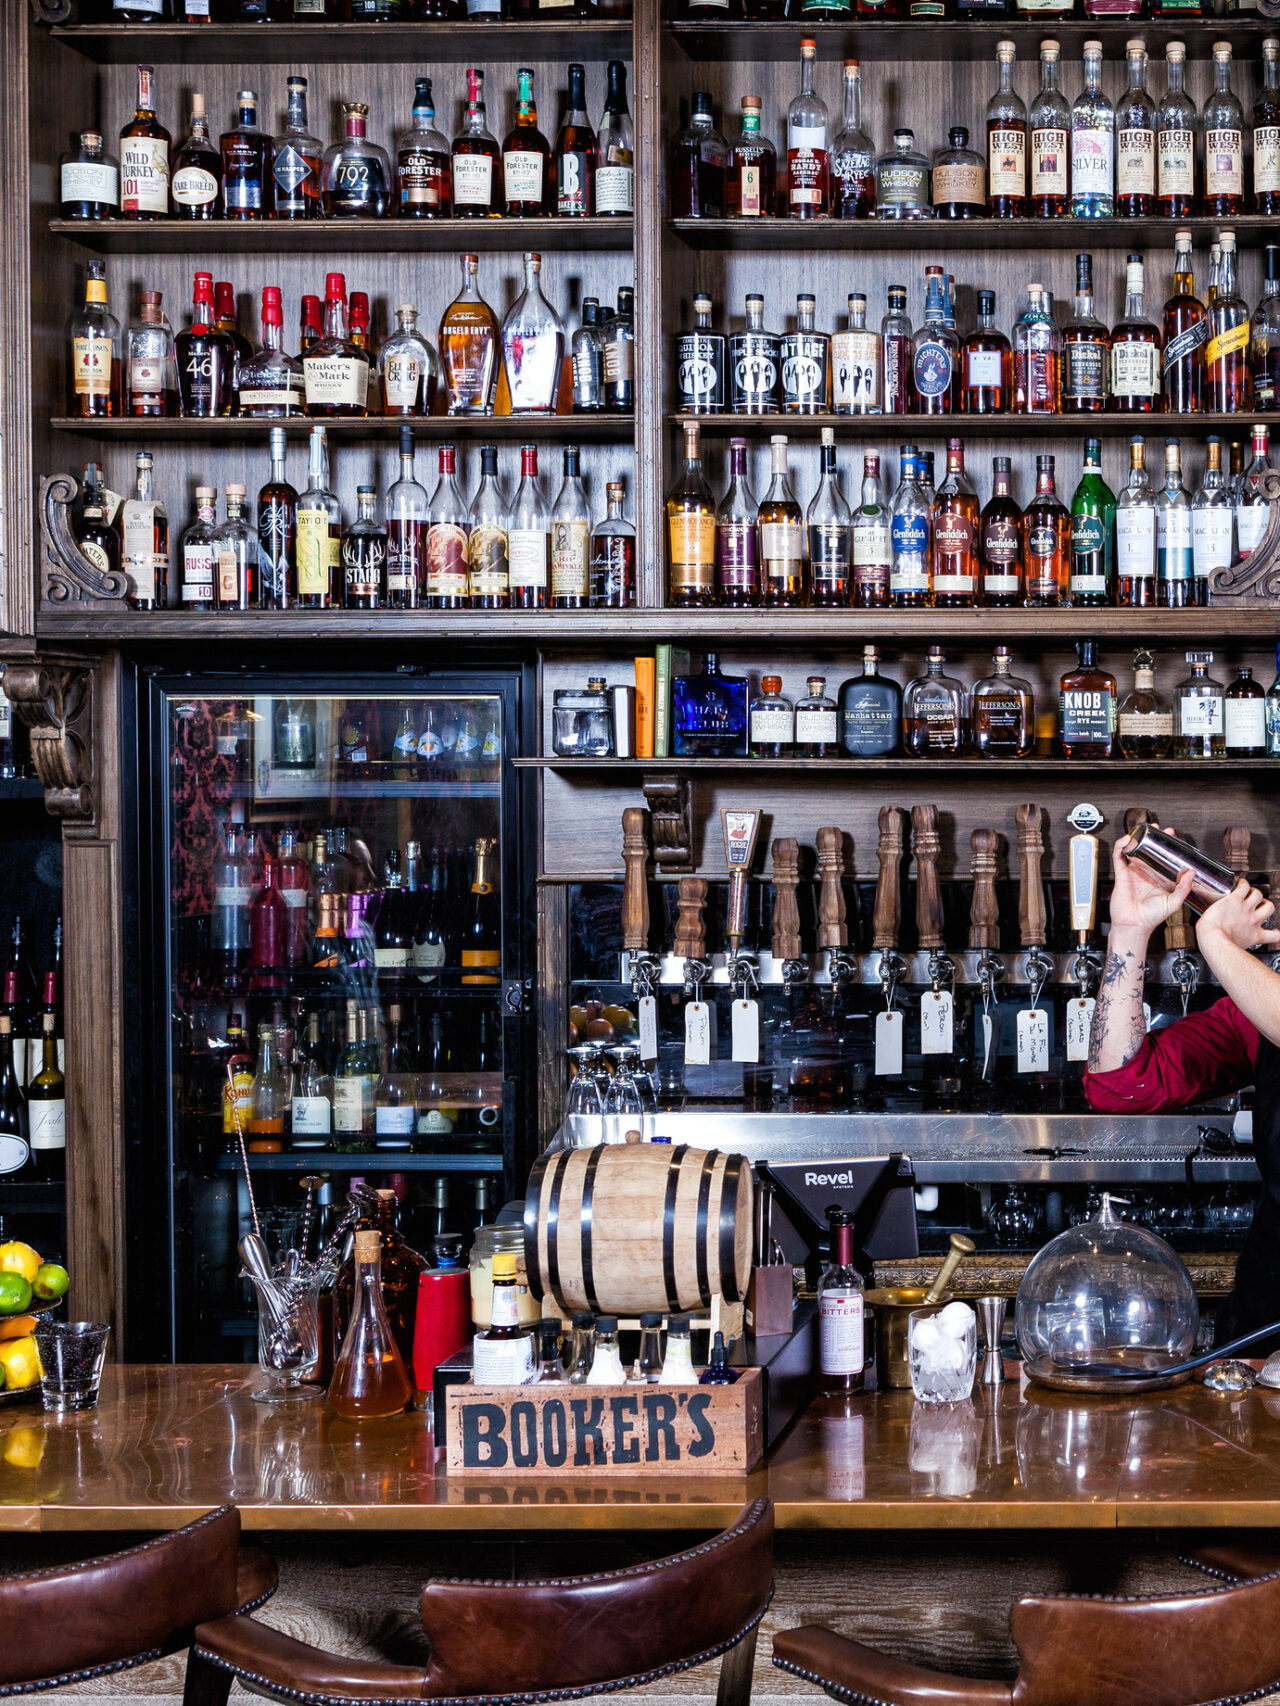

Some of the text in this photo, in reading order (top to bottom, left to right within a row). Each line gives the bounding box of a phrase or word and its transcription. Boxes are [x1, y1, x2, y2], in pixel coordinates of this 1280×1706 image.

[992, 132, 1024, 142] HIGH
[1034, 132, 1064, 142] HIGH
[1120, 132, 1152, 142] HIGH
[1159, 132, 1192, 142] HIGH
[1208, 132, 1239, 142] HIGH
[992, 142, 1024, 150] WEST
[1034, 142, 1064, 150] WEST
[126, 152, 149, 165] WILD
[408, 157, 426, 166] OLD
[456, 165, 488, 173] FORESTER
[506, 162, 538, 170] FORESTER
[791, 163, 821, 171] HANDY
[835, 157, 870, 177] SAZERAC
[1073, 158, 1108, 170] SILVER
[122, 164, 154, 178] TURKEY
[335, 166, 369, 186] 1792
[398, 166, 442, 176] FORESTER
[564, 154, 579, 195] B
[935, 169, 978, 177] HUDSON
[122, 179, 139, 195] 101
[173, 181, 187, 192] RARE
[189, 180, 213, 192] BREED
[881, 179, 919, 188] WHISKEY
[558, 201, 583, 210] BAKER'S
[470, 326, 488, 335] ENVY
[890, 340, 899, 371] BERNHEIM
[917, 349, 947, 369] MICHTER'S
[1072, 349, 1101, 360] Dickel
[1119, 349, 1148, 359] Dickel
[604, 342, 620, 377] KNOB
[186, 358, 213, 379] 46
[307, 362, 351, 371] Maker's
[577, 352, 591, 382] KNOB
[319, 370, 350, 380] Mark
[1083, 375, 1091, 384] 8
[299, 516, 328, 526] TAYLOR
[893, 528, 926, 540] Glenfiddich
[935, 528, 969, 540] Glenfiddich
[1117, 526, 1152, 535] MACALLAN
[1158, 525, 1192, 534] MACALLAN
[1195, 526, 1230, 535] MACALLAN
[855, 535, 887, 544] GLENLIVET
[986, 537, 1018, 549] Glenfiddich
[1030, 536, 1054, 546] Glenfiddich
[347, 567, 381, 584] STAGG
[201, 587, 212, 597] 10
[1065, 692, 1101, 708] KNOB
[914, 701, 955, 711] JEFFERSON'S
[979, 701, 1022, 711] JEFFERSON'S
[755, 713, 793, 721] HUDSON
[800, 713, 837, 721] HUDSON
[844, 711, 892, 721] Manhattan
[1069, 709, 1106, 717] CREEK
[657, 711, 665, 740] BOTANIST
[755, 723, 791, 731] WHISKEY
[800, 723, 837, 732] WHISKEY
[938, 1002, 949, 1037] PERONI
[1037, 1023, 1044, 1034] LA
[1077, 1010, 1085, 1043] WIZARD
[804, 1170, 853, 1187] Revel
[822, 1307, 860, 1316] BITTERS
[463, 1393, 716, 1469] BOOKER'S
